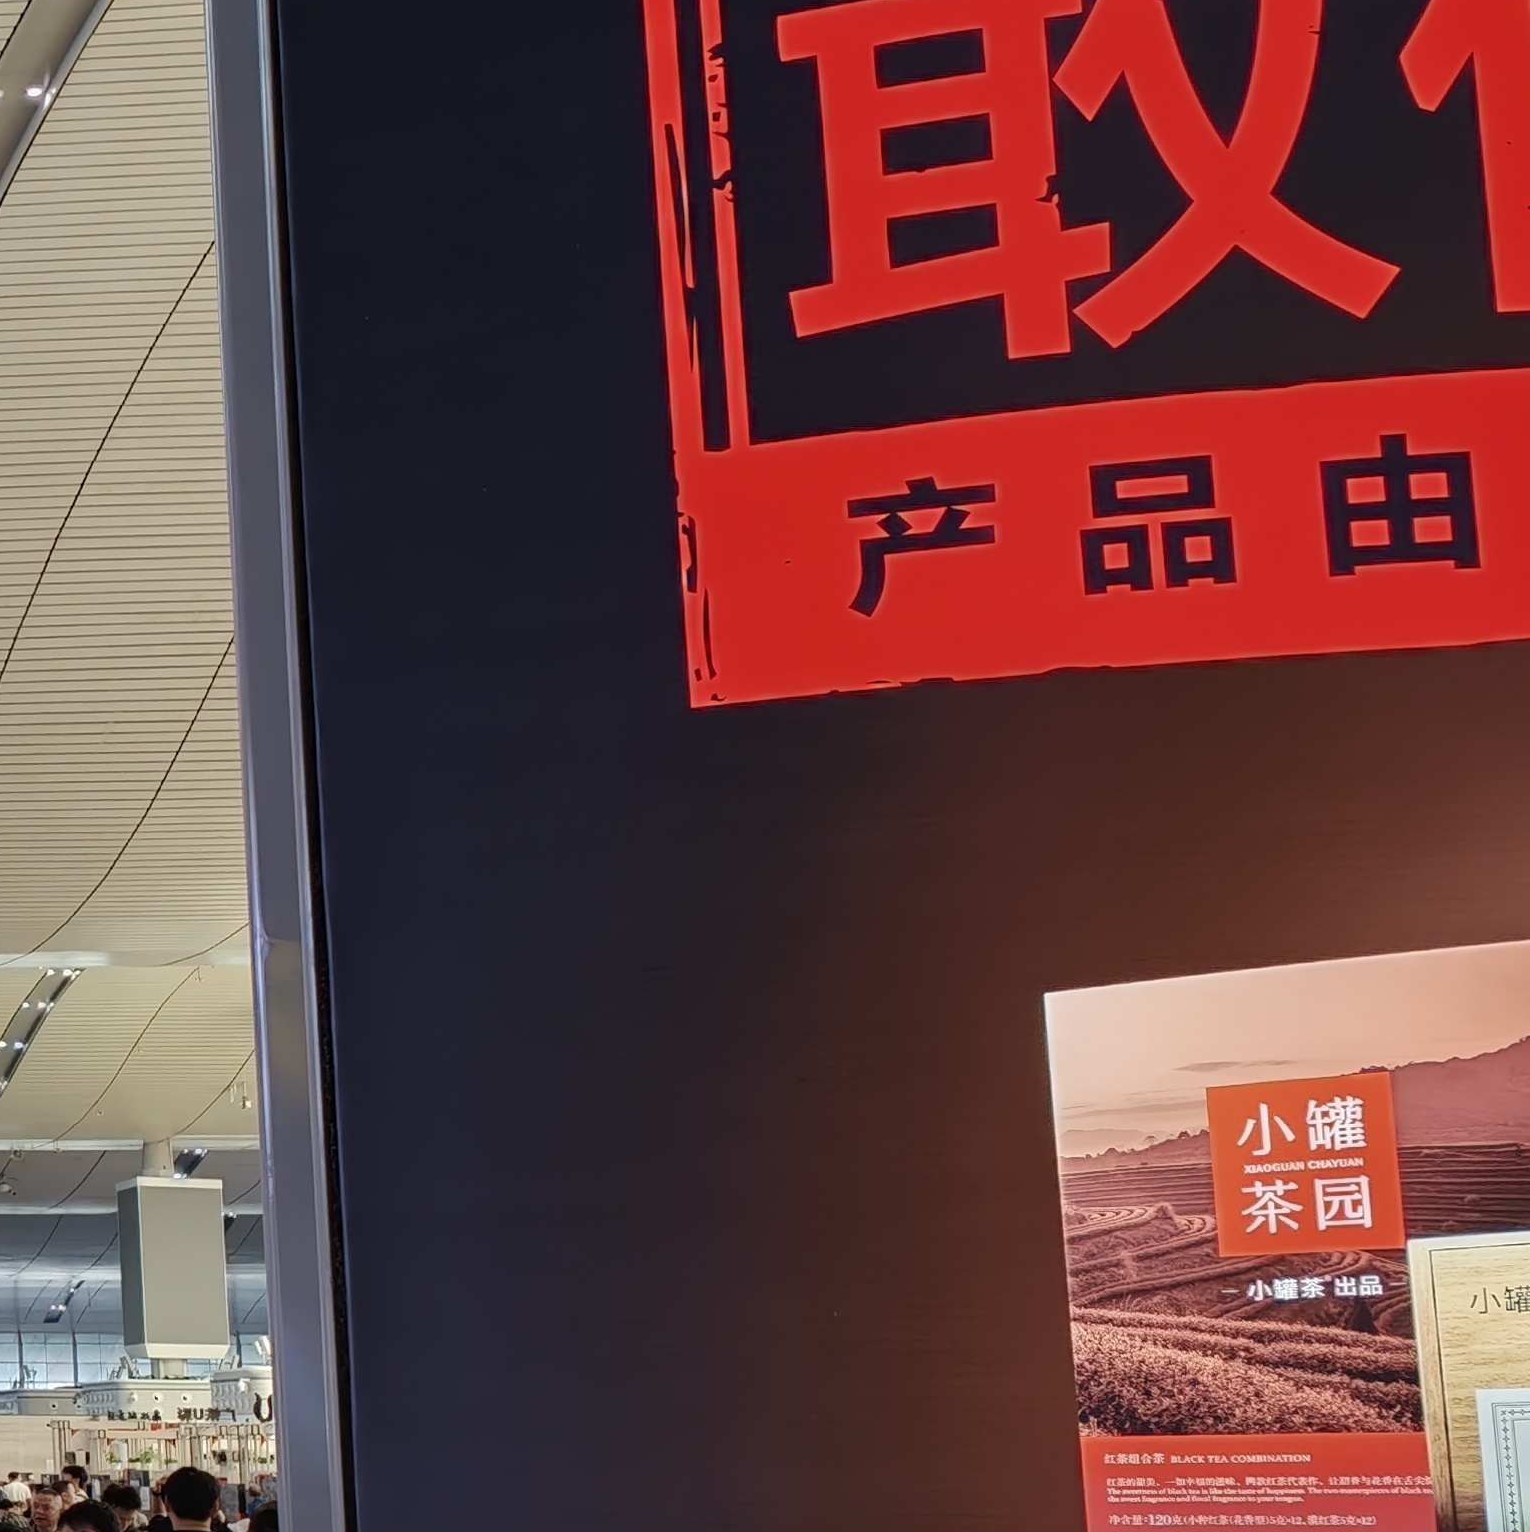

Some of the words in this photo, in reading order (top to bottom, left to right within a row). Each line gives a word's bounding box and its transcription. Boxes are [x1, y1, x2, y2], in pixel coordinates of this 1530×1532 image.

[1236, 1095, 1368, 1157] 小罐
[1240, 1175, 1374, 1235] 茶园
[1104, 1452, 1166, 1465] 红茶组合茶
[1170, 1454, 1206, 1464] BLACK
[1207, 1454, 1229, 1464] TEA
[1230, 1454, 1312, 1464] COMBINATION
